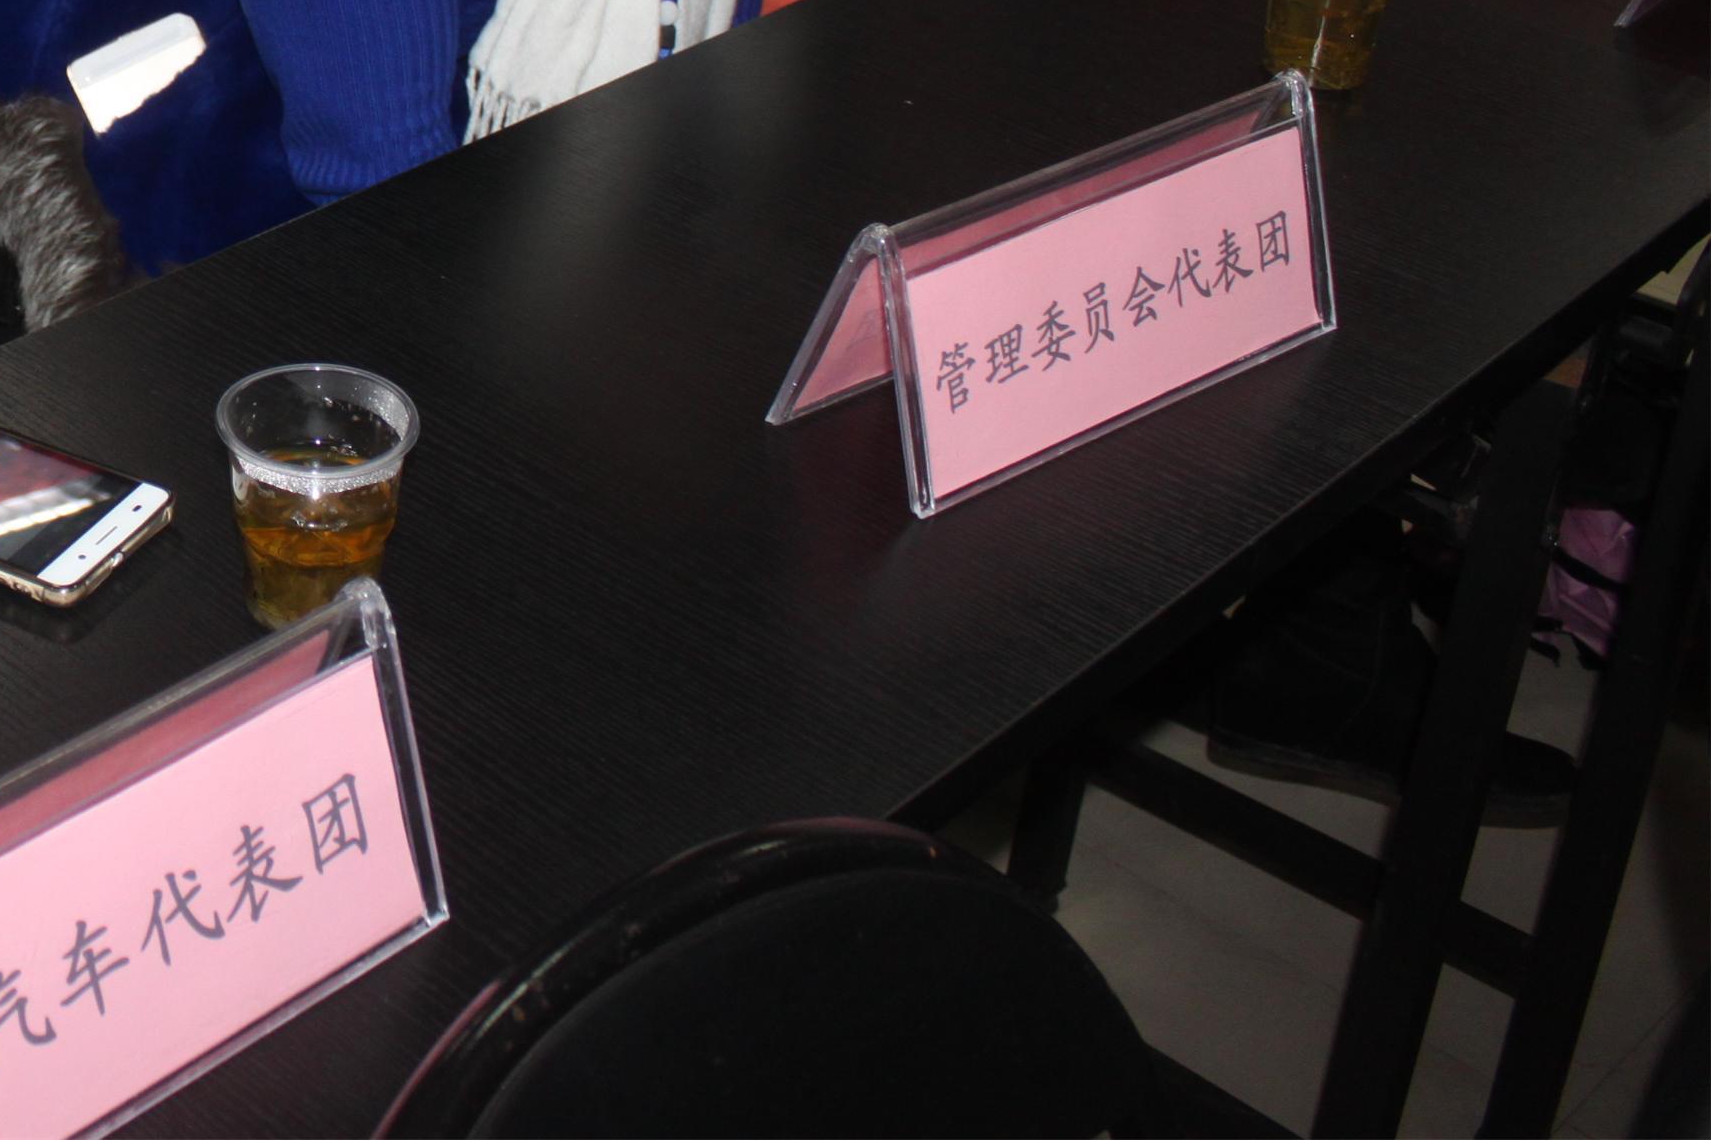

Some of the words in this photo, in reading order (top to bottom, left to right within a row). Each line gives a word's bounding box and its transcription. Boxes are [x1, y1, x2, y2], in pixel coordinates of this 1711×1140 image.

[935, 210, 1290, 414] 管理委员会代表团
